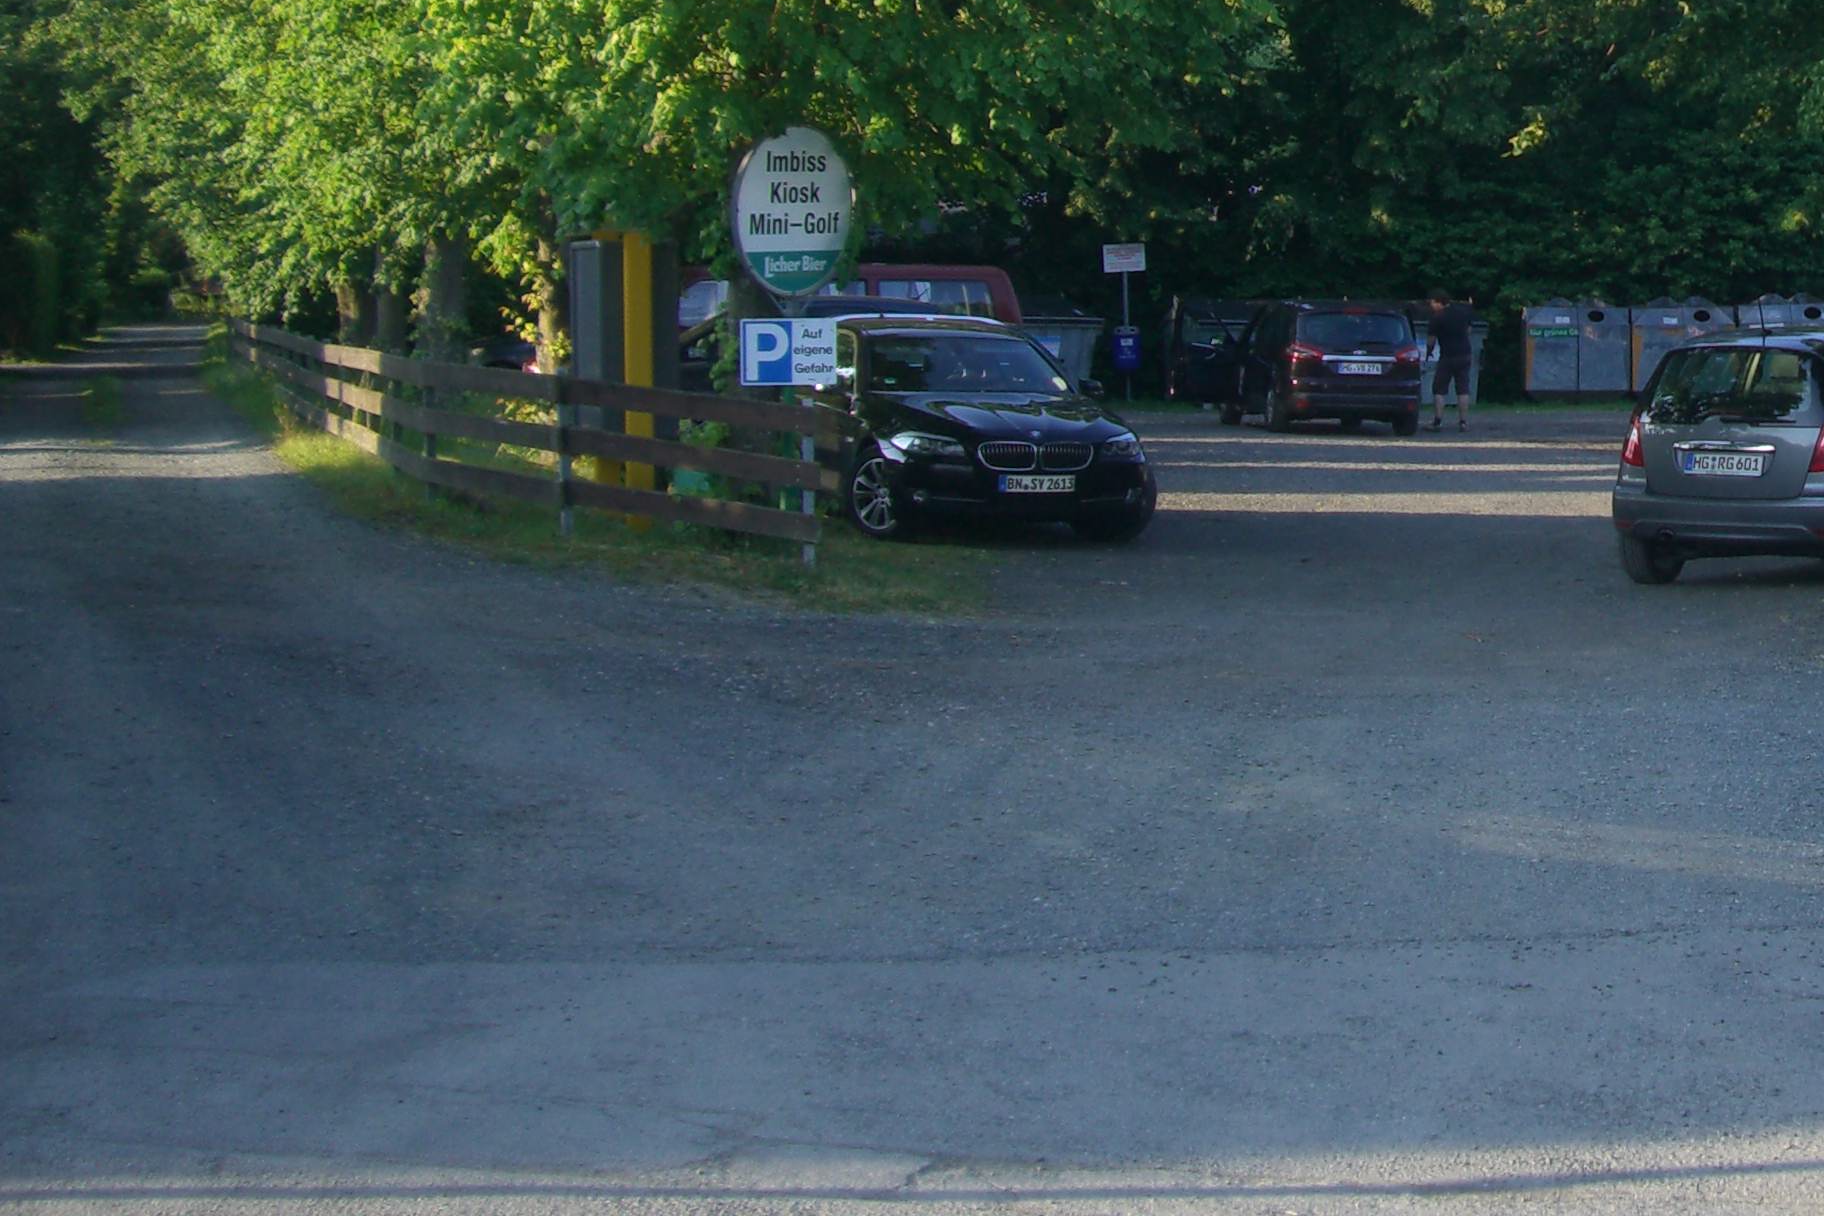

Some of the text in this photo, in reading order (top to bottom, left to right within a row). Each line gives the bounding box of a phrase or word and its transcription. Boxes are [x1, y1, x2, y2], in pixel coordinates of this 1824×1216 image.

[766, 151, 827, 172] Imbiss
[770, 181, 820, 203] Kiosk
[750, 211, 840, 235] Mini-Golf
[764, 255, 827, 278] Licher Bier
[801, 328, 823, 339] Auf
[745, 324, 790, 381] P
[793, 344, 833, 357] eigene
[794, 362, 834, 374] Gefahr
